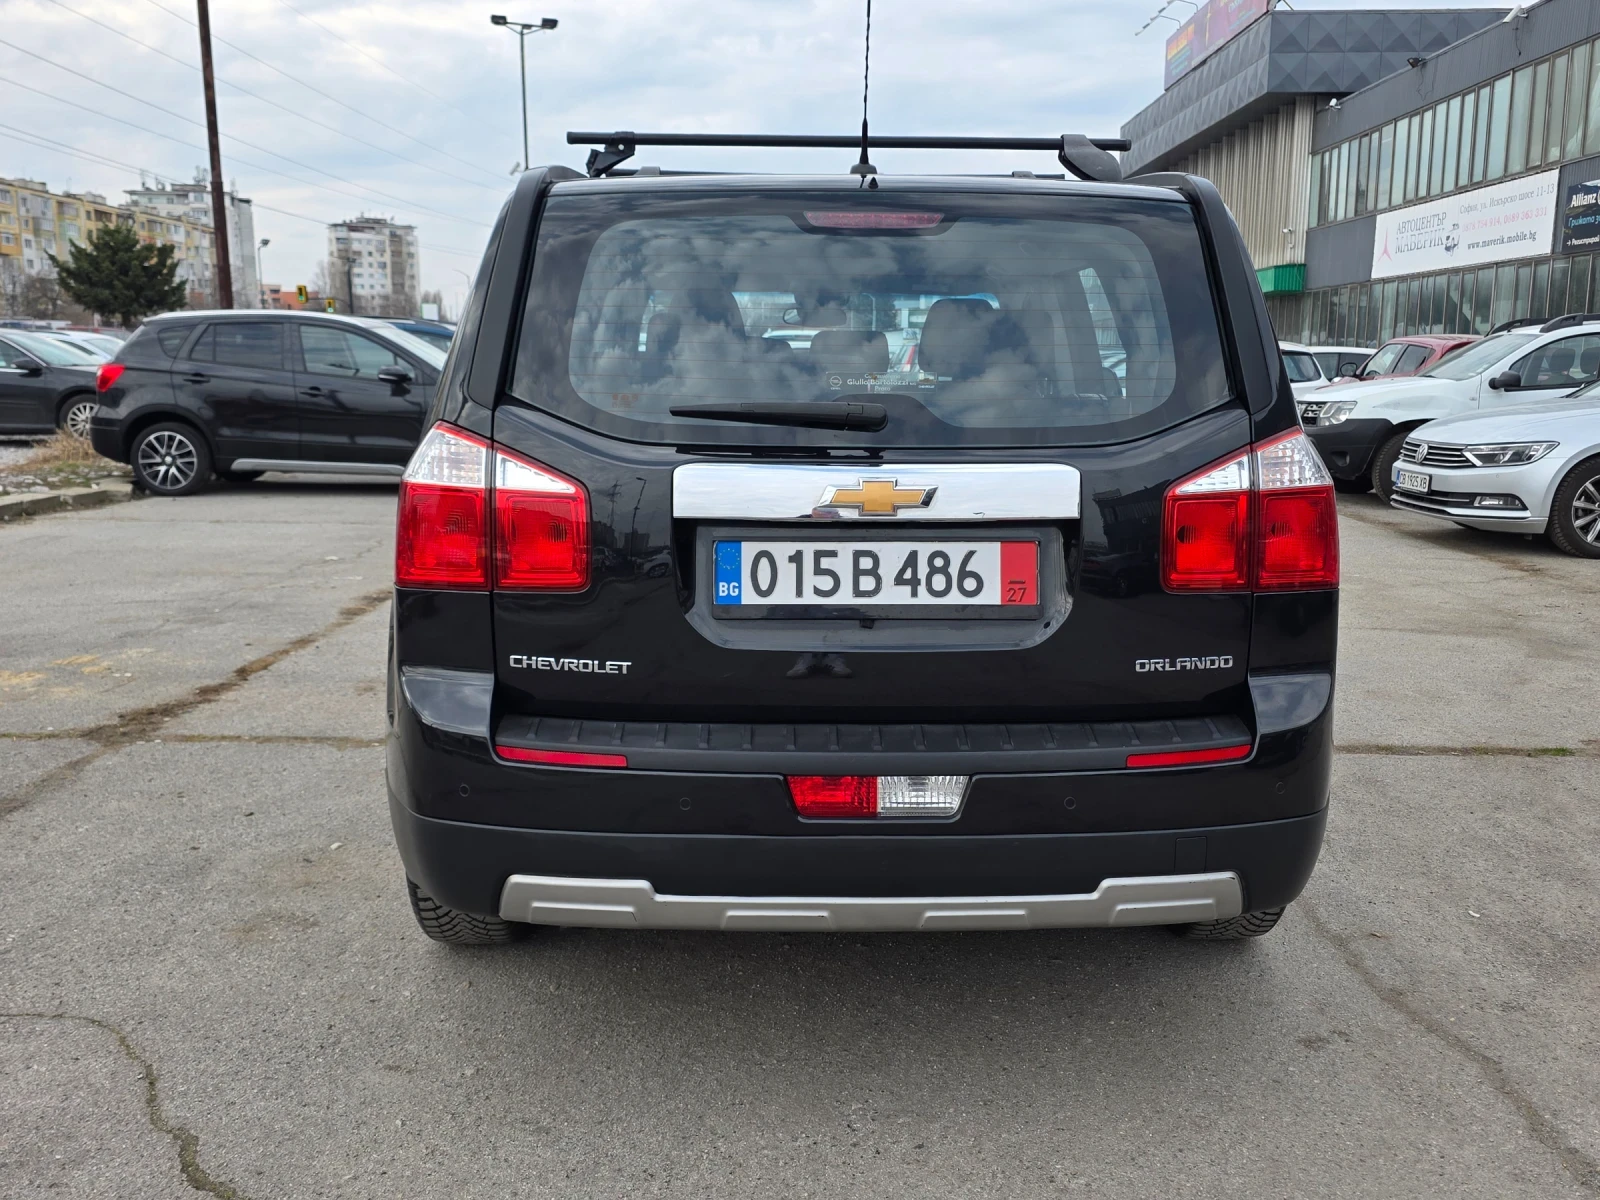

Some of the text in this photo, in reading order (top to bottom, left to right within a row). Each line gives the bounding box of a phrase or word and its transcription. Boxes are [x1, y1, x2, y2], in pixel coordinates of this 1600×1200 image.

[1489, 194, 1518, 208] Искърско
[1518, 190, 1535, 201] шосе
[1536, 183, 1555, 197] 11-13
[1571, 191, 1597, 208] Allianz
[1396, 211, 1447, 235] АВТОЦЕНТЪР
[1395, 228, 1445, 254] МАВЕРИК
[1467, 230, 1537, 250] www.maverik.mobile.bg
[1406, 473, 1419, 488] 1925
[1419, 476, 1428, 490] XB
[718, 582, 739, 597] BG
[1006, 587, 1028, 603] 27
[509, 654, 632, 674] CHEVROLET
[1135, 655, 1234, 672] ORLANDO
